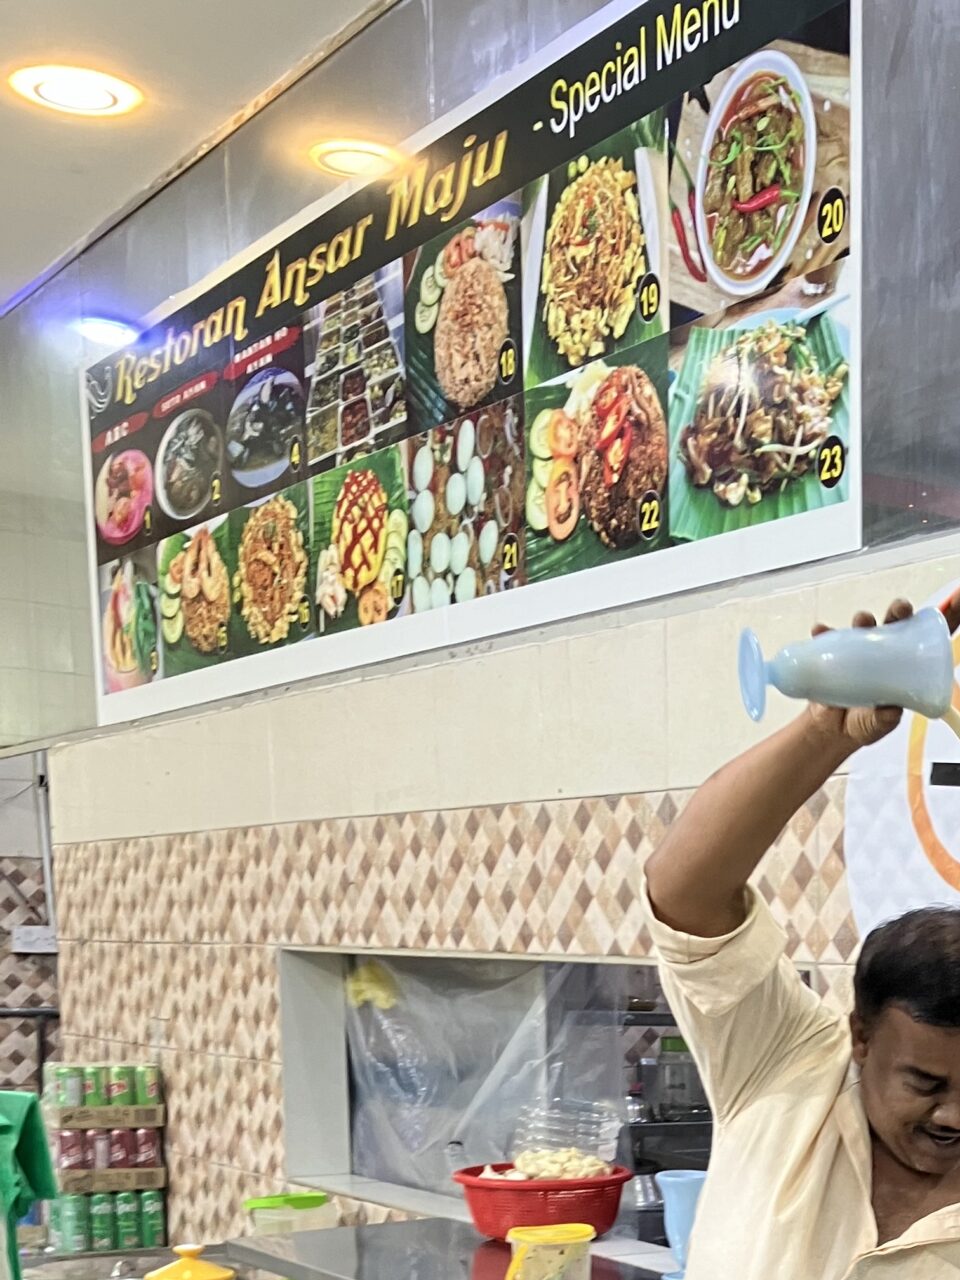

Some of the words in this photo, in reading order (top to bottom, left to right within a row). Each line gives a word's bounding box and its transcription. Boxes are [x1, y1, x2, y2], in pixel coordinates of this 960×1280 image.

[113, 295, 247, 405] Restoran
[256, 214, 374, 319] Ansar
[385, 129, 508, 241] Maju
[549, 25, 647, 139] Special
[656, 0, 740, 72] Menu
[821, 203, 844, 238] 20
[640, 286, 660, 317] 19
[499, 353, 516, 377] 18
[820, 446, 843, 481] 23
[640, 502, 660, 532] 22
[502, 542, 518, 567] 21
